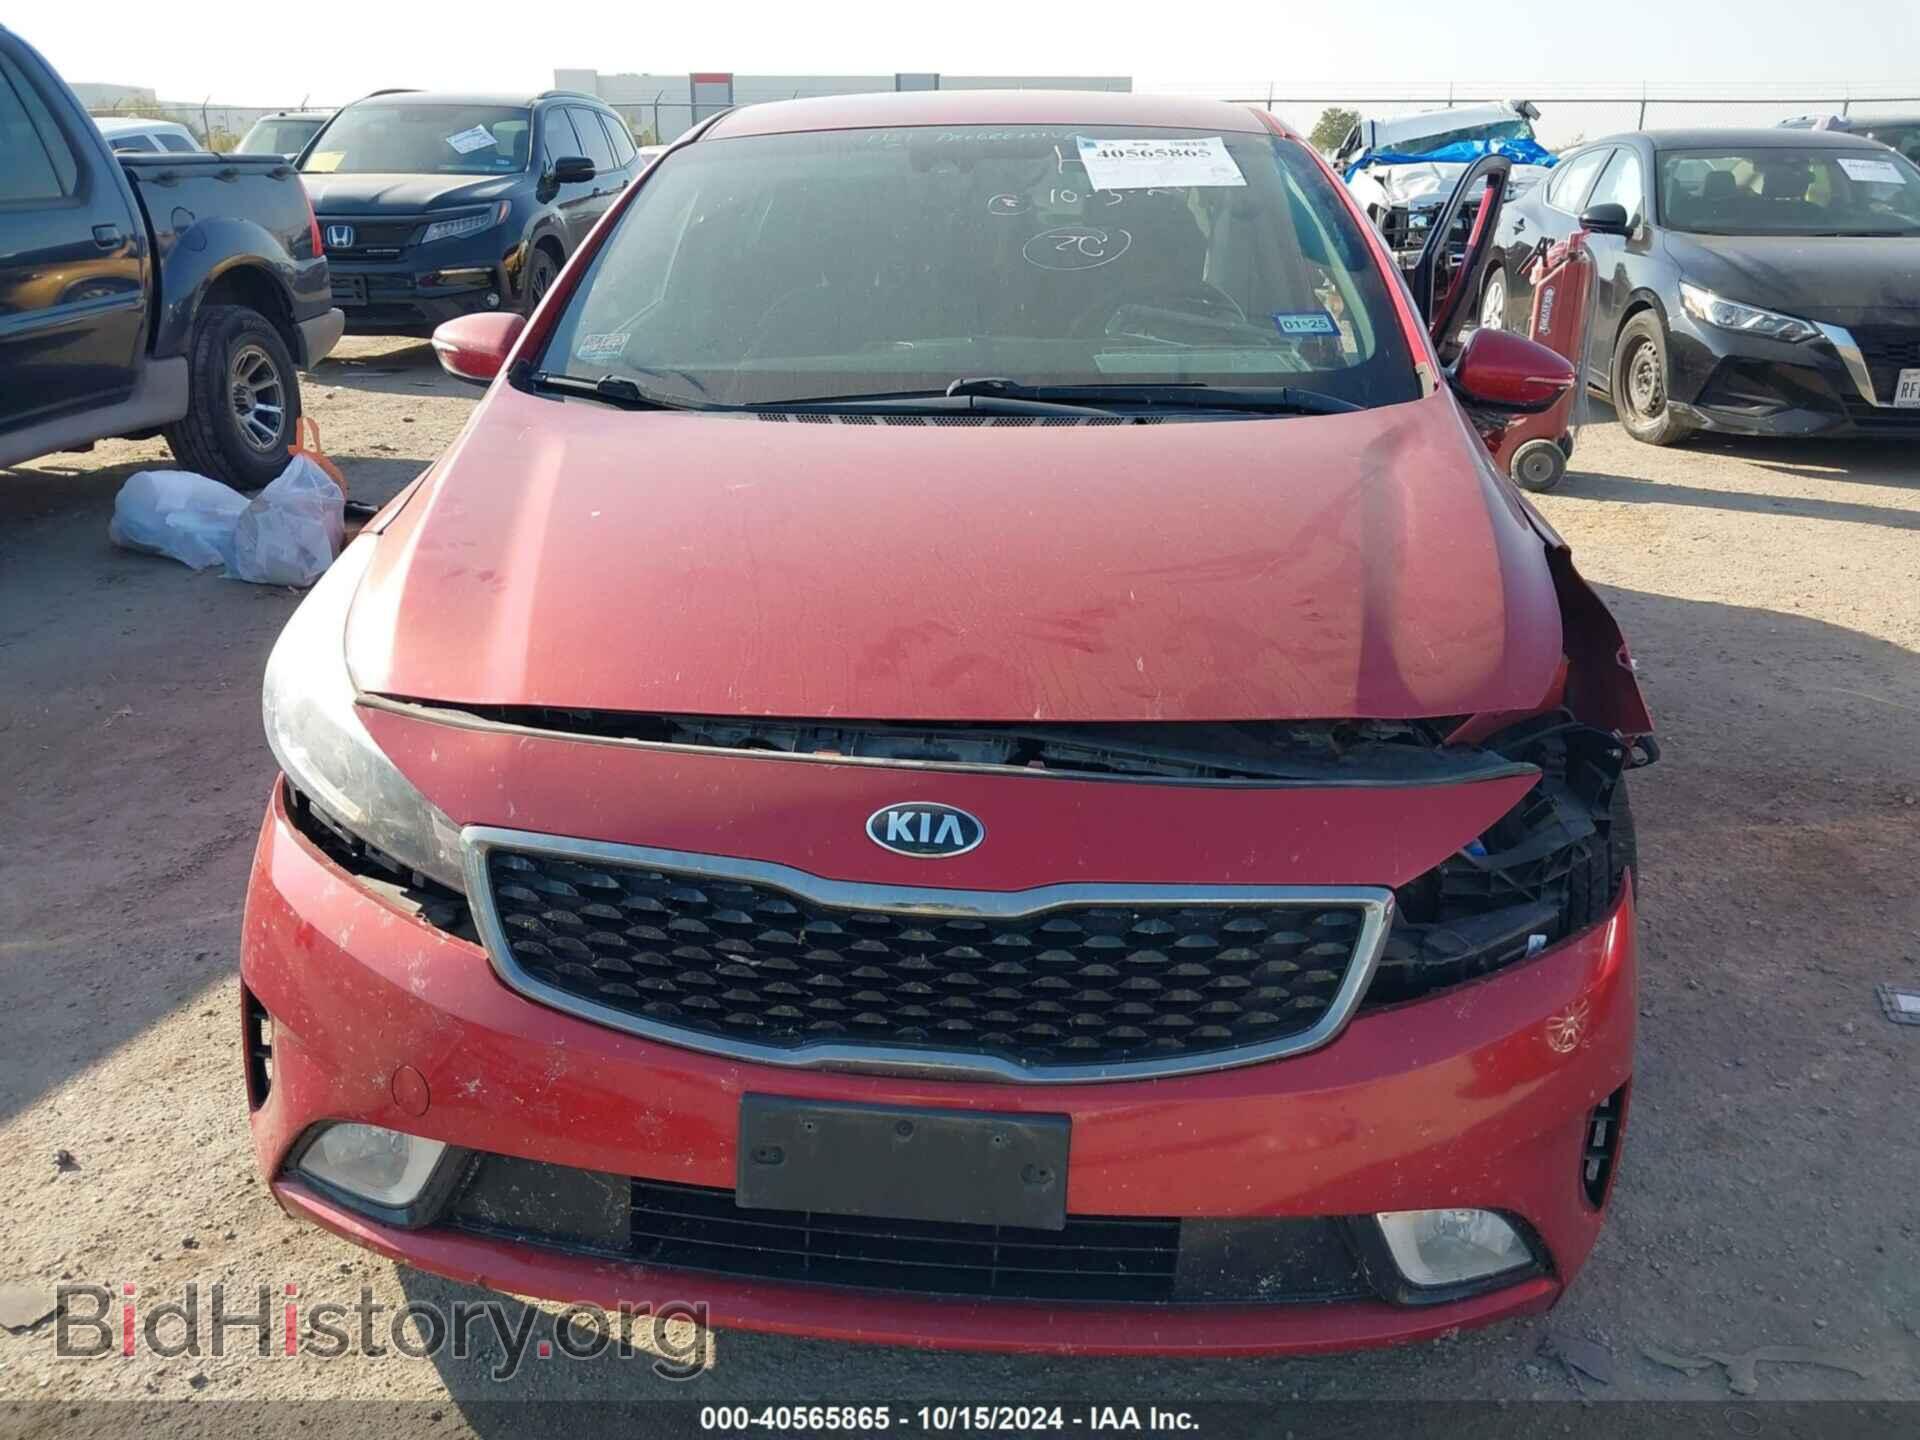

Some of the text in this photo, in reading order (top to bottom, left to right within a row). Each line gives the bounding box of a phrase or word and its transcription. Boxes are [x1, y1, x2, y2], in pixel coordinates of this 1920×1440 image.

[1097, 149, 1213, 158] 40565865
[1901, 382, 1920, 398] RF
[887, 811, 965, 846] KIA
